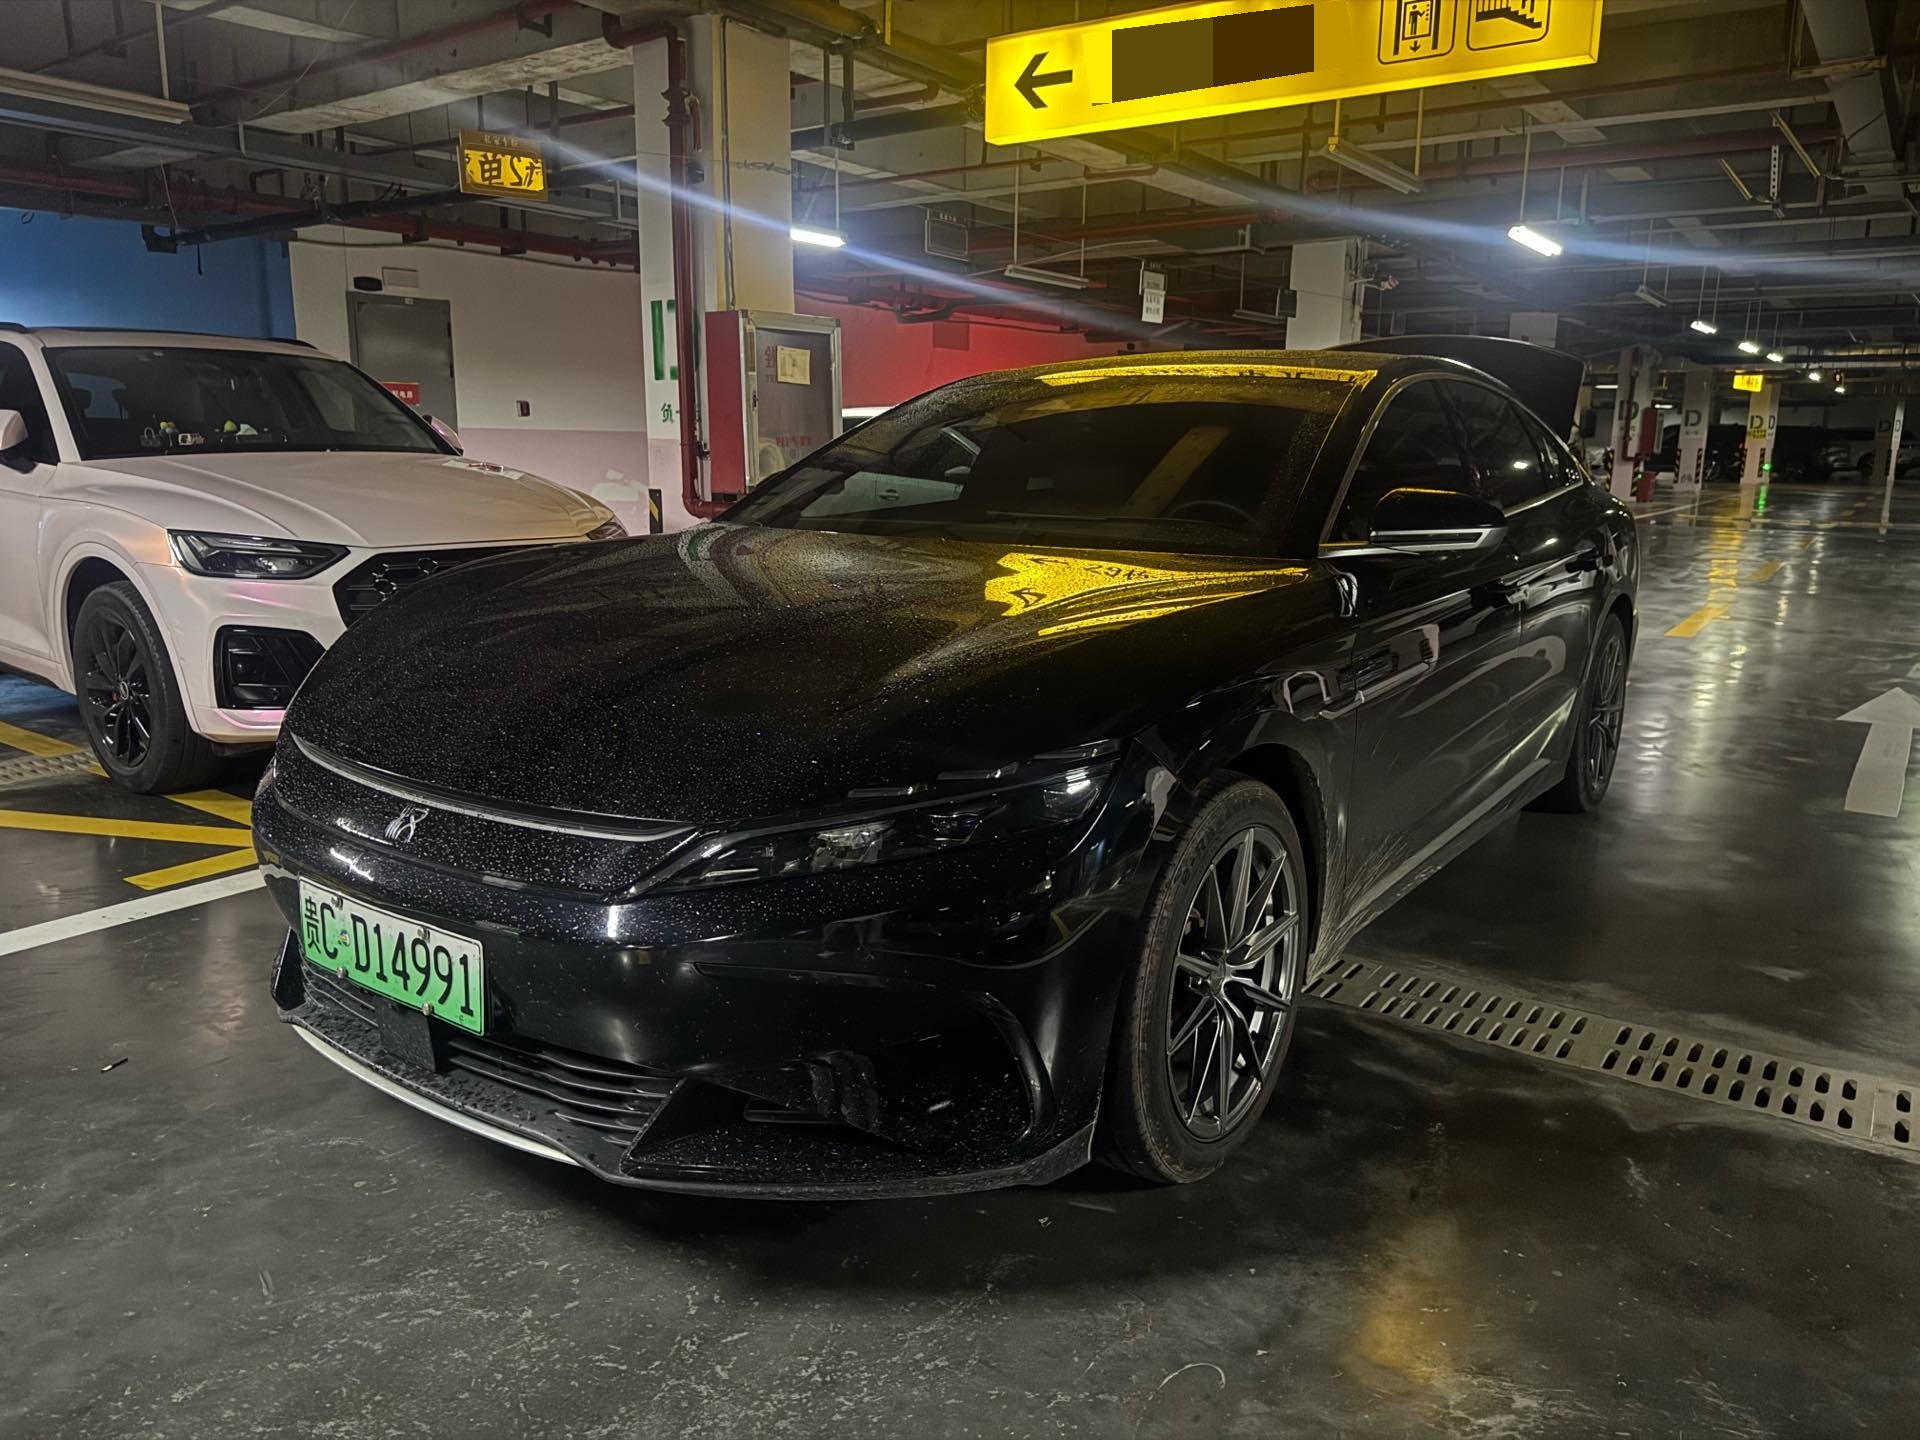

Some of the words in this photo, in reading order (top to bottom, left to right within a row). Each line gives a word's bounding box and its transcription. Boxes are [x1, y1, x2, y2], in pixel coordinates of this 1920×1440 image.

[1684, 409, 1702, 427] D
[1750, 415, 1764, 429] D
[1768, 415, 1776, 430] D
